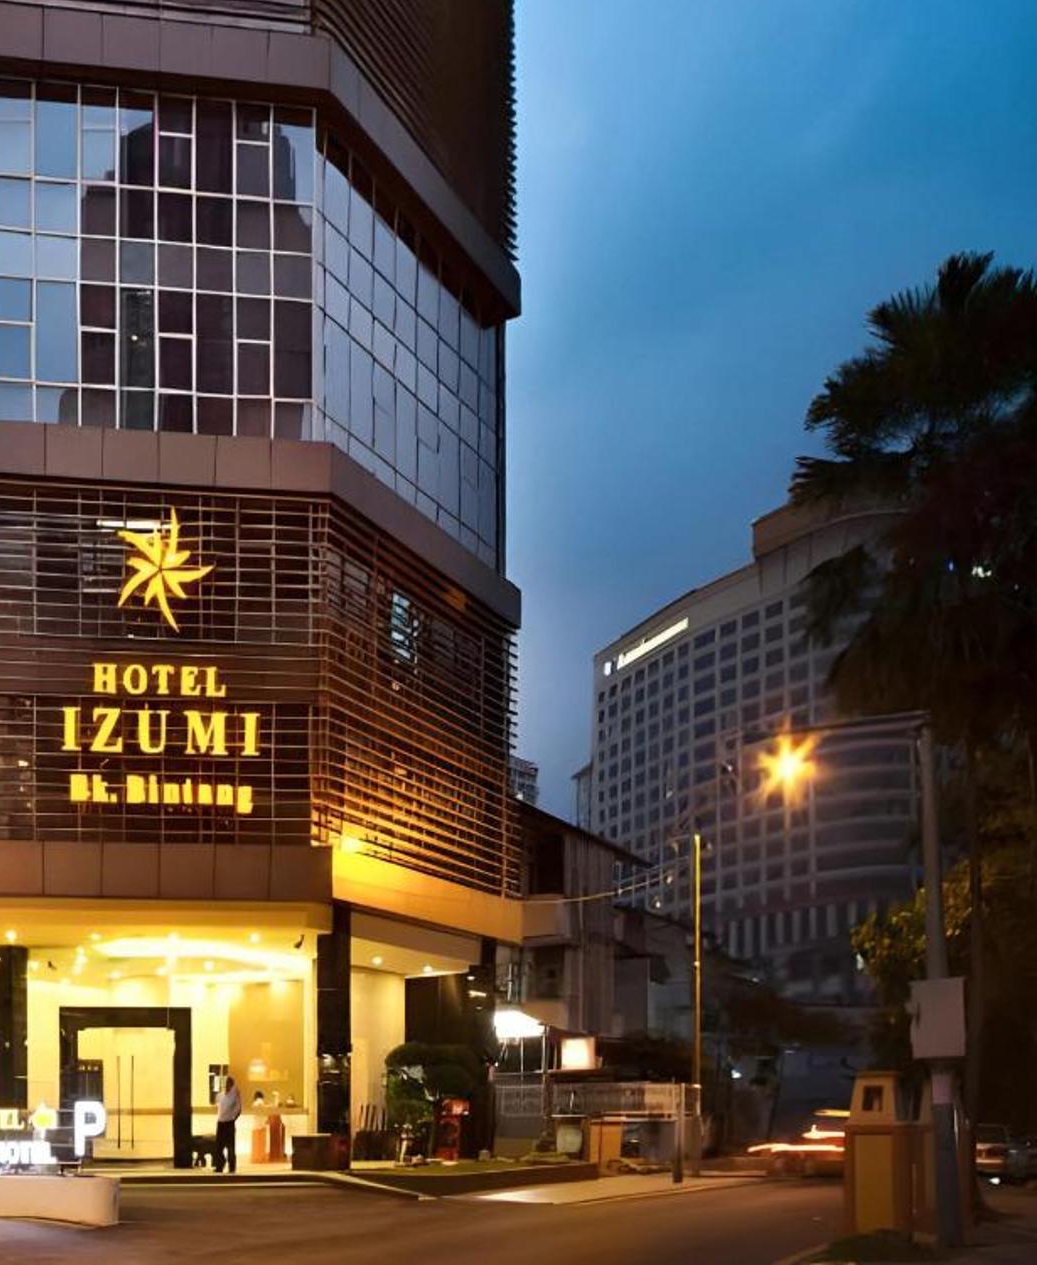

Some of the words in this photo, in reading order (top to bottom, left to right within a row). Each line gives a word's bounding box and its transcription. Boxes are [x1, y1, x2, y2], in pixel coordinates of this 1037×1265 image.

[92, 662, 226, 698] HOTEL
[61, 706, 260, 757] IZUMI
[74, 1101, 106, 1157] P
